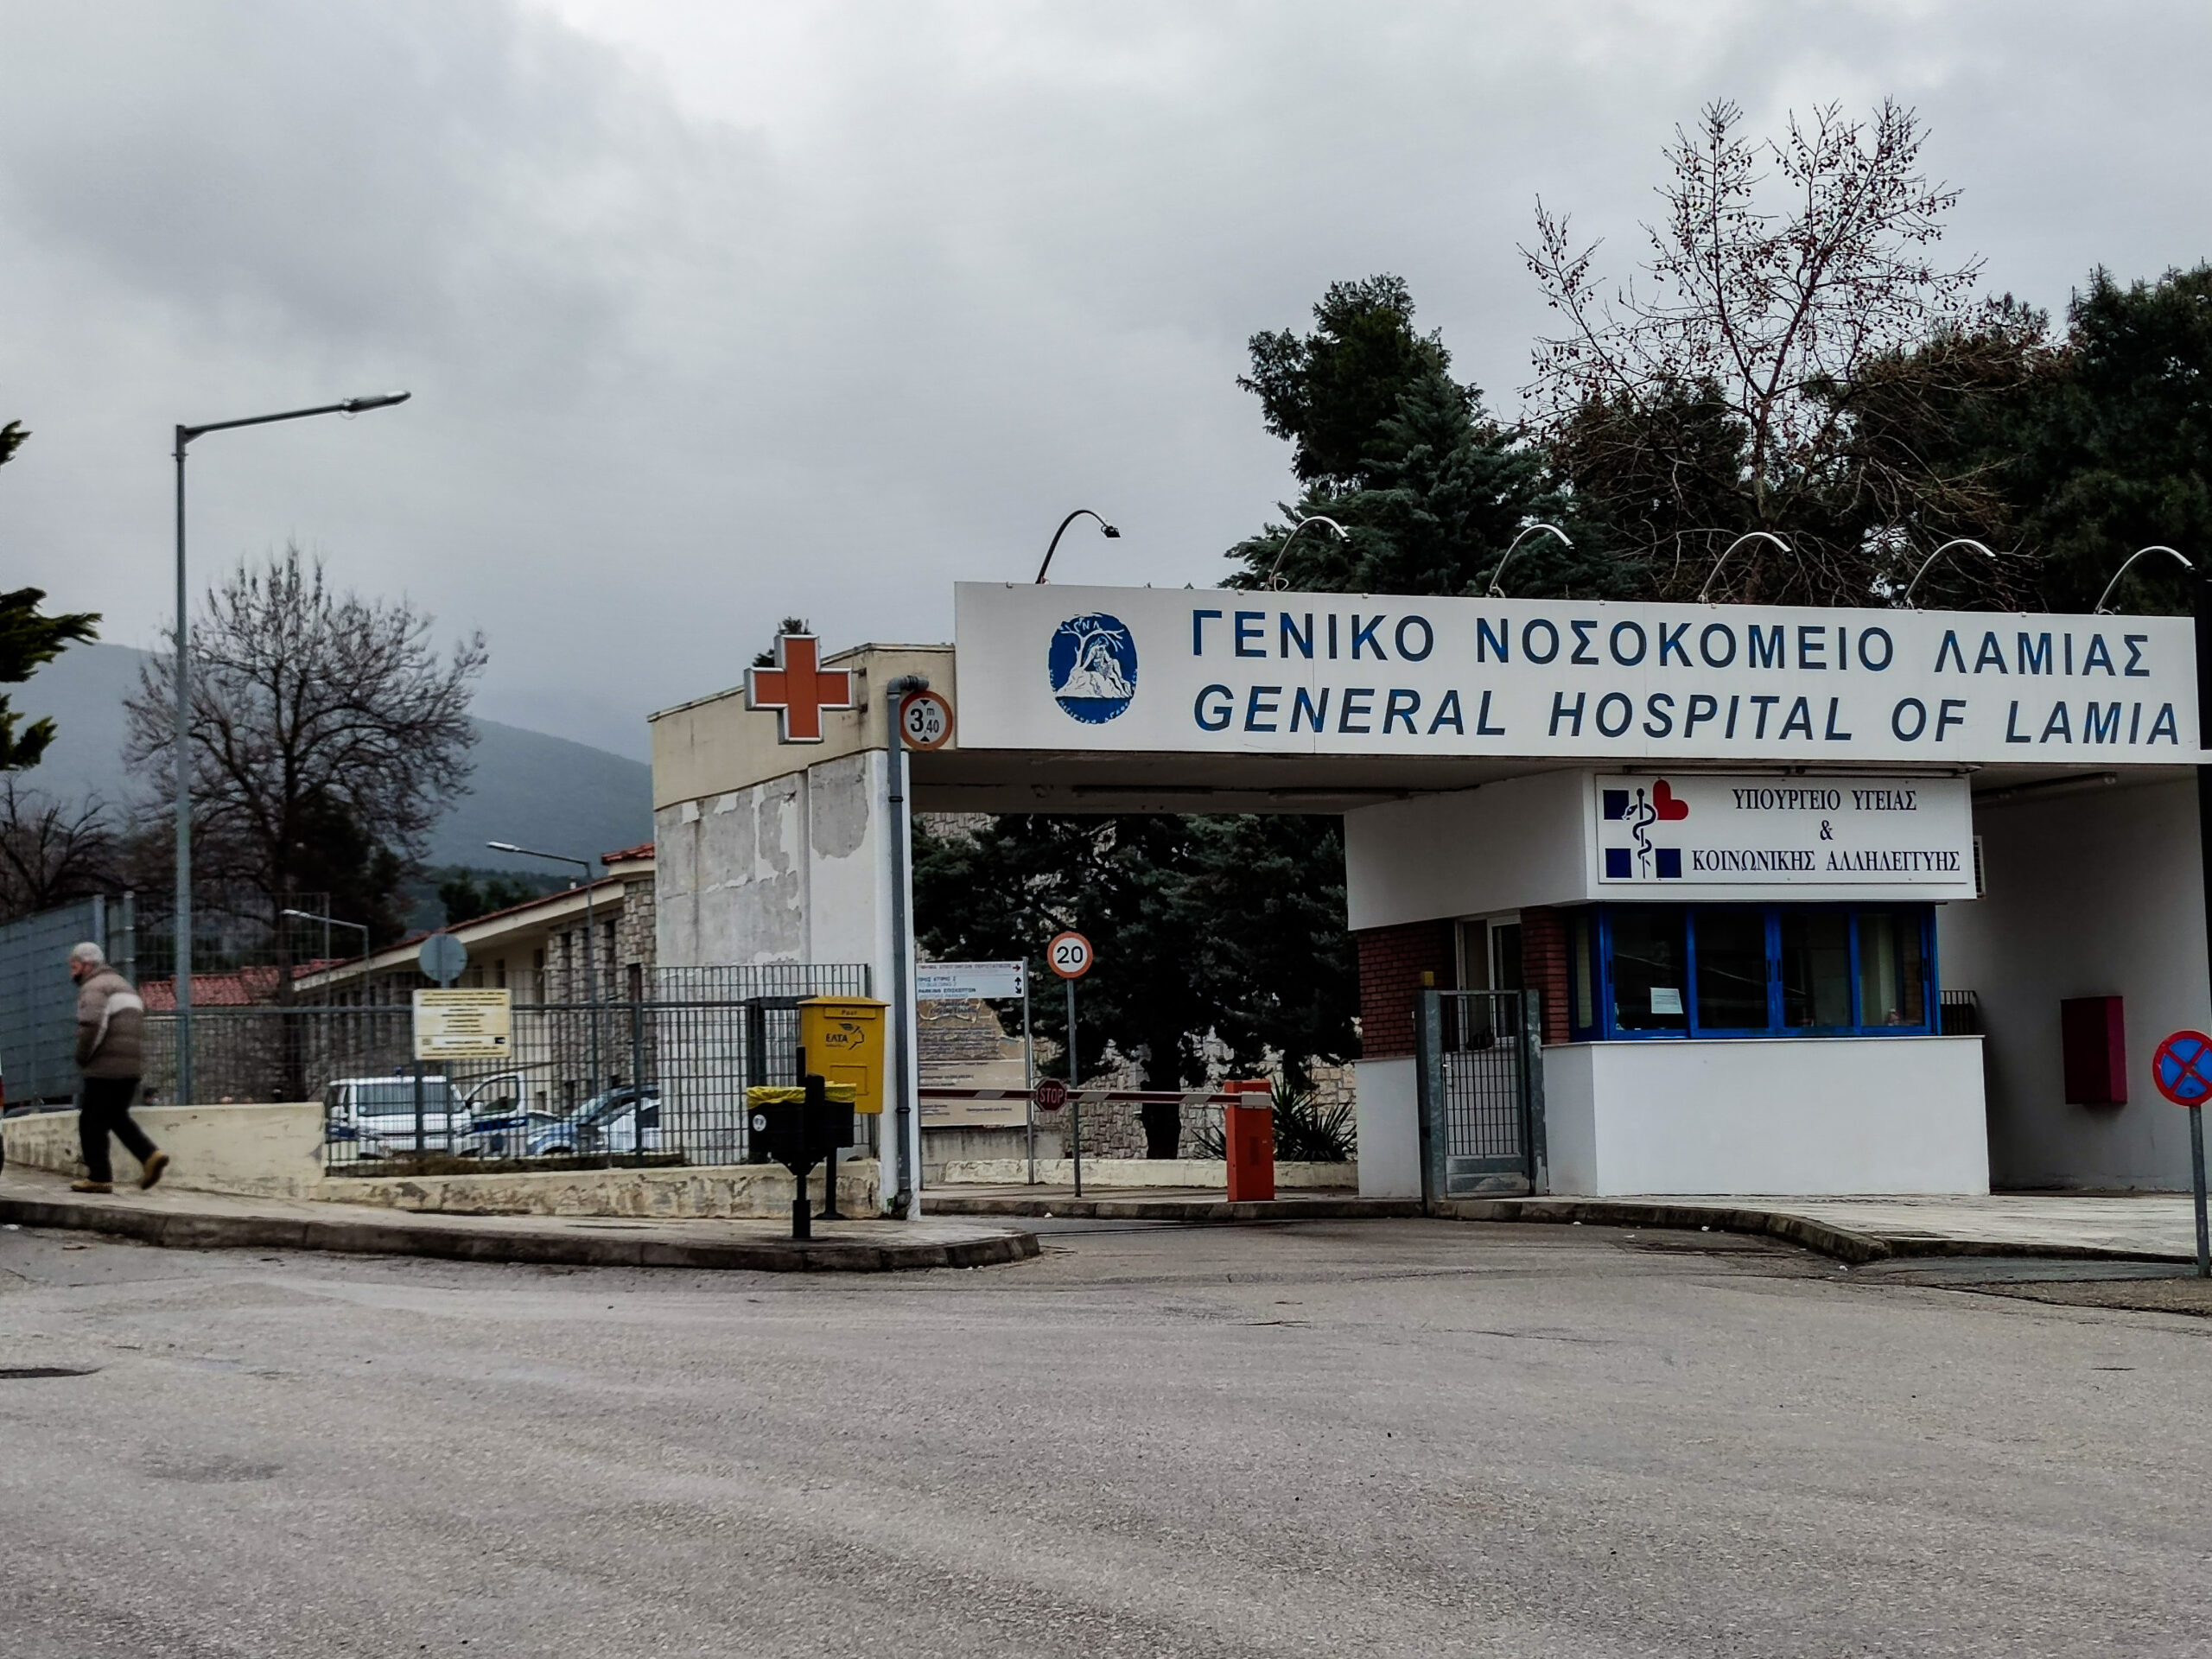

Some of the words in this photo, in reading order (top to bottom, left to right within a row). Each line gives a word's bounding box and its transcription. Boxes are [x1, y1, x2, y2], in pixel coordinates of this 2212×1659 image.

[1192, 609, 1435, 663] ΓΕΝΙΚΟ
[1476, 617, 1895, 672] ΝΟΣΟΚΟΜΕΙΟ
[1934, 629, 2152, 677] ΛΑΜΙΑΣ
[1193, 683, 1507, 736] GENERAL
[1548, 691, 1853, 741] HOSPITAL
[1891, 697, 1968, 742] OF
[2005, 700, 2180, 745] LAMIA
[1732, 788, 1841, 811] ΥΠΟΥΡΓΕΙΟ
[1852, 789, 1917, 811] ΥΓΕΙΑΣ
[1819, 819, 1834, 841] &
[1691, 849, 1815, 872] ΚΟΙΝΩΝΙΚΗΣ
[1825, 850, 1961, 872] ΑΛΛΗΛΕΓΓΥΗΣ
[1057, 945, 1083, 964] 20
[1039, 1087, 1064, 1103] STOP
